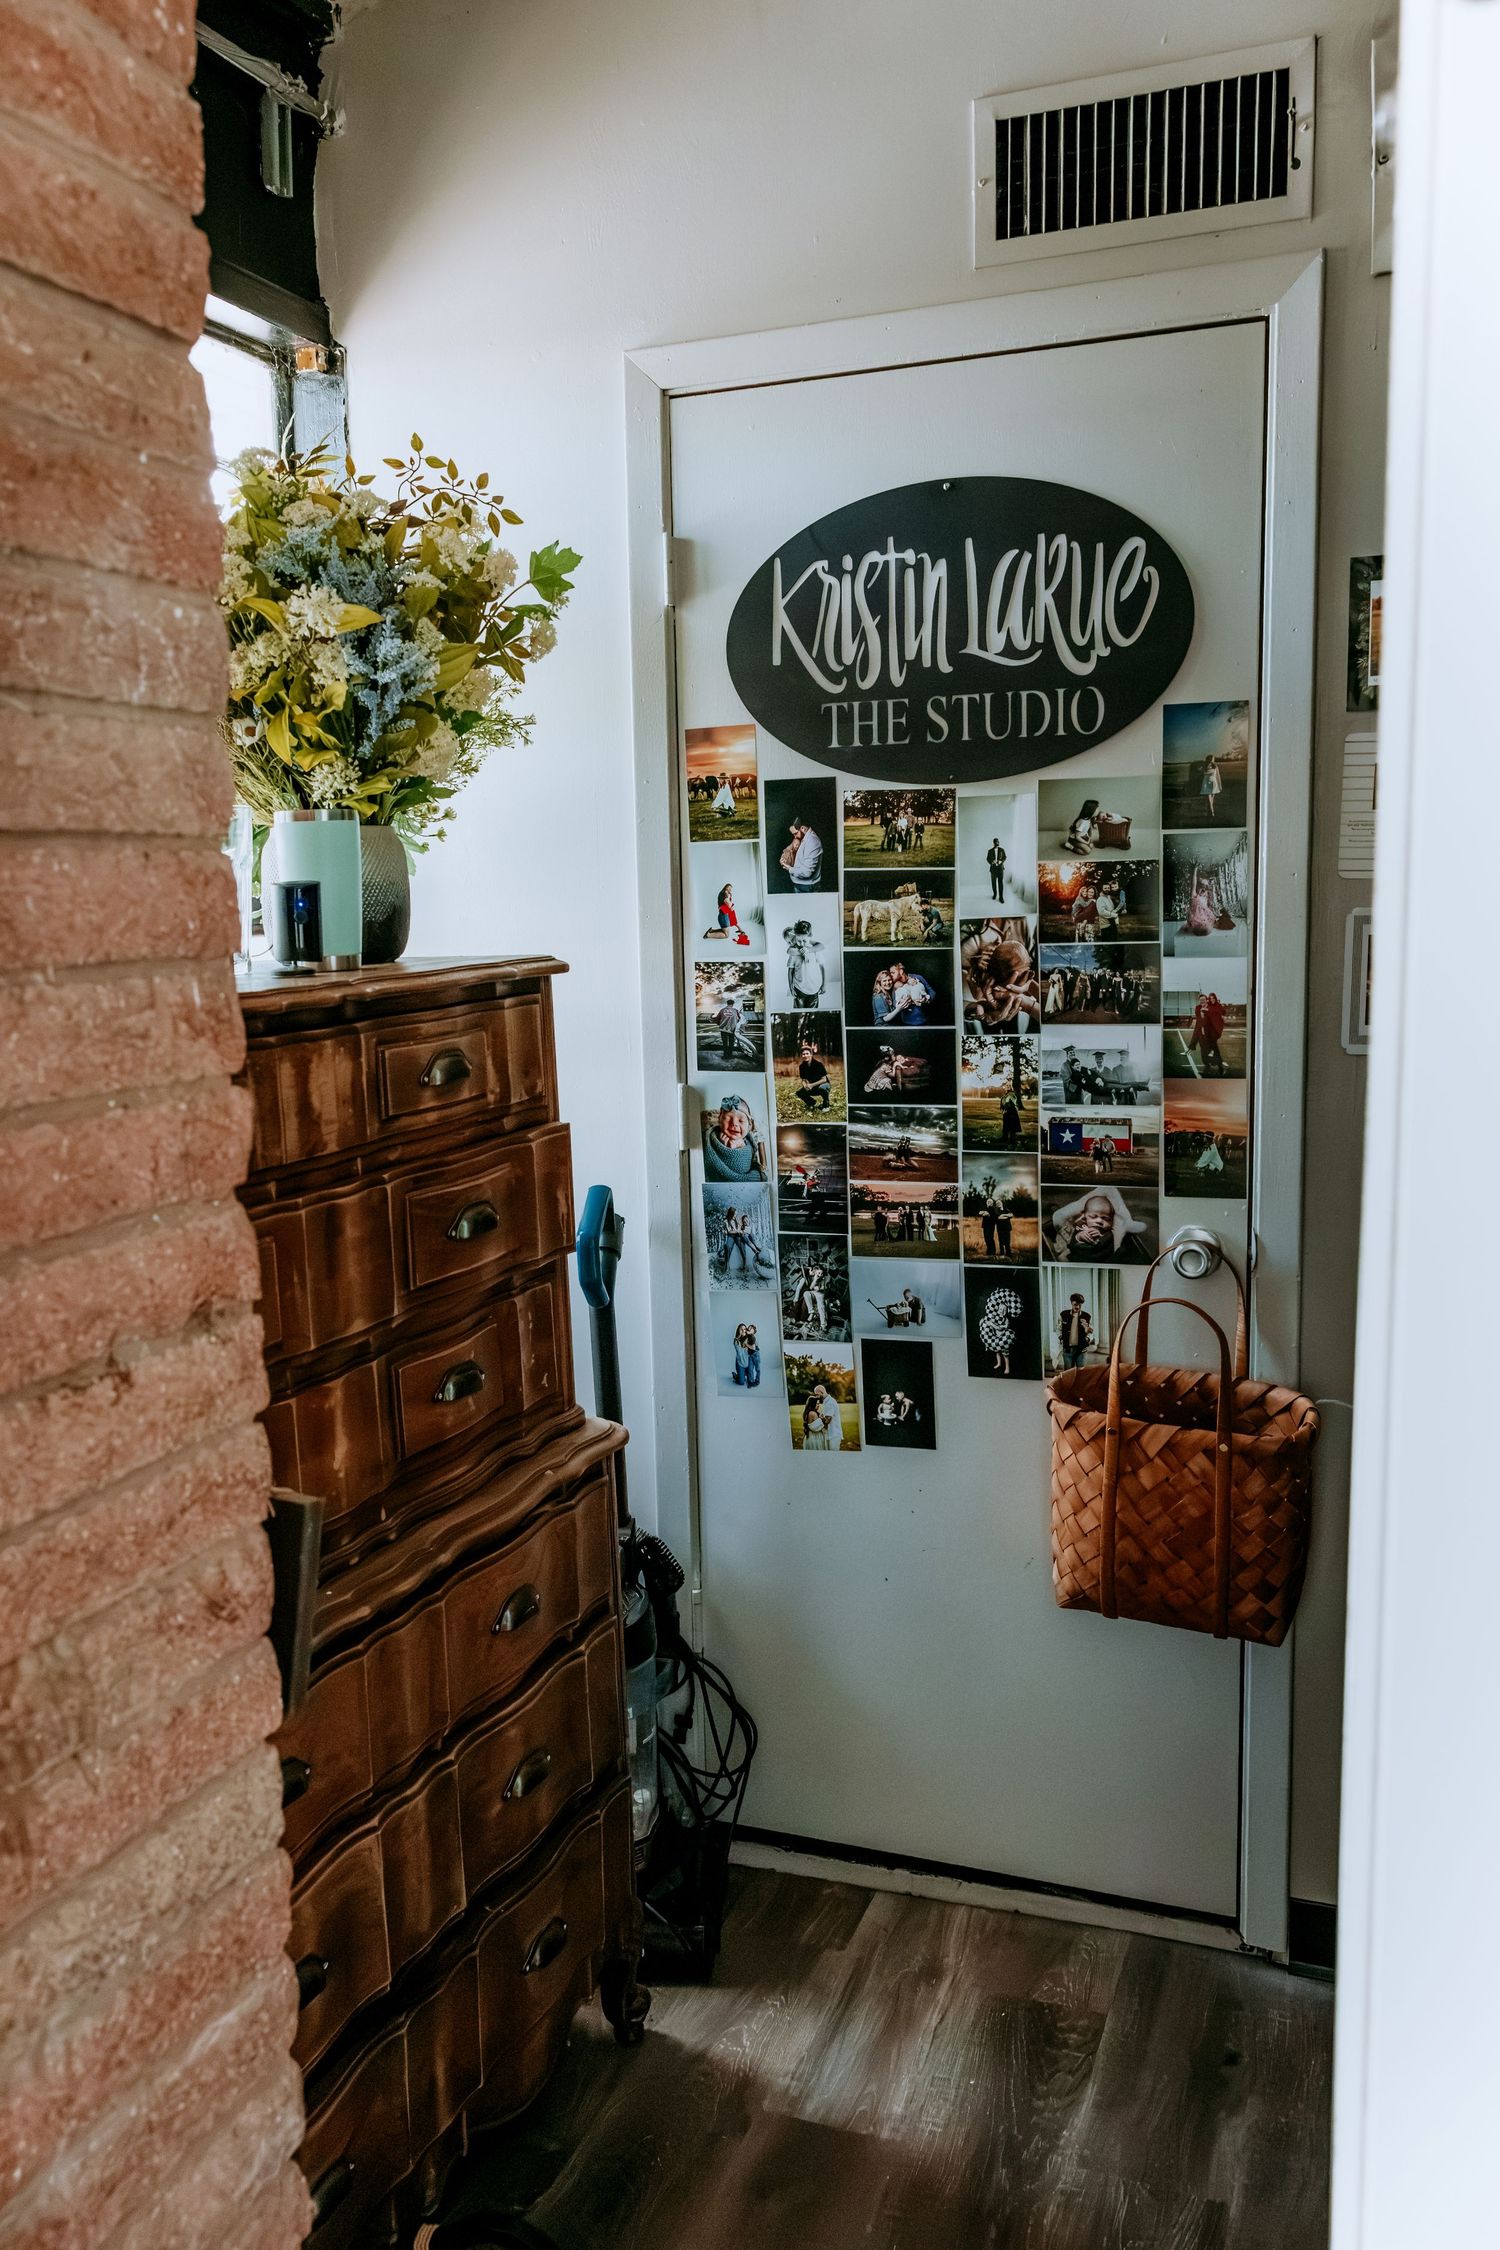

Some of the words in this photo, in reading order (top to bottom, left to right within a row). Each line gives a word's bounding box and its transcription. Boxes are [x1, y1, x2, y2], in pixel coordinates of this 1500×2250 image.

[772, 535, 953, 694] Kristin
[821, 699, 910, 749] THE
[925, 686, 1105, 743] STUDIO
